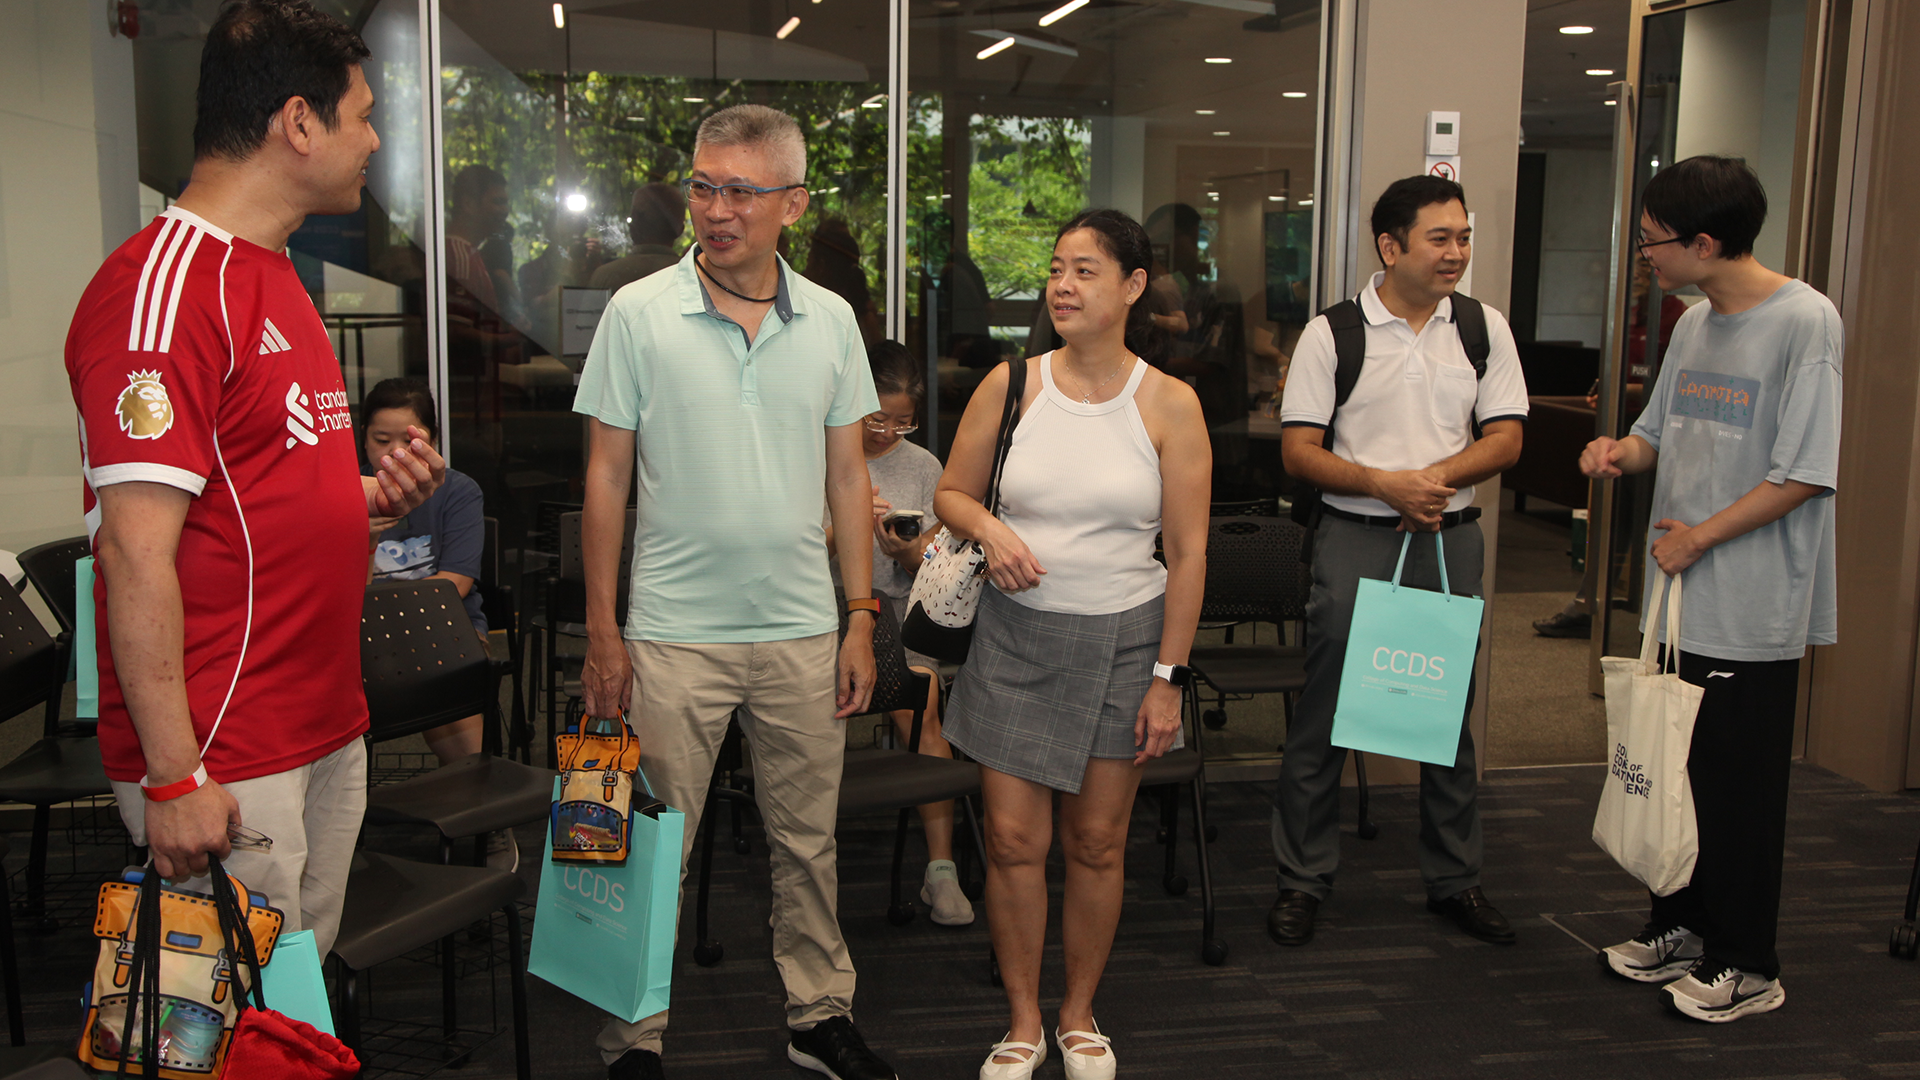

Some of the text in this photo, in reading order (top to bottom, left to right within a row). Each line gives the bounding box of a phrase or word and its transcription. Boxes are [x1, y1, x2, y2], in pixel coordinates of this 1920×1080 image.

[1632, 366, 1648, 376] PUSH
[1373, 647, 1446, 680] CCDS
[1630, 764, 1643, 772] OF
[564, 864, 625, 912] CCDS
